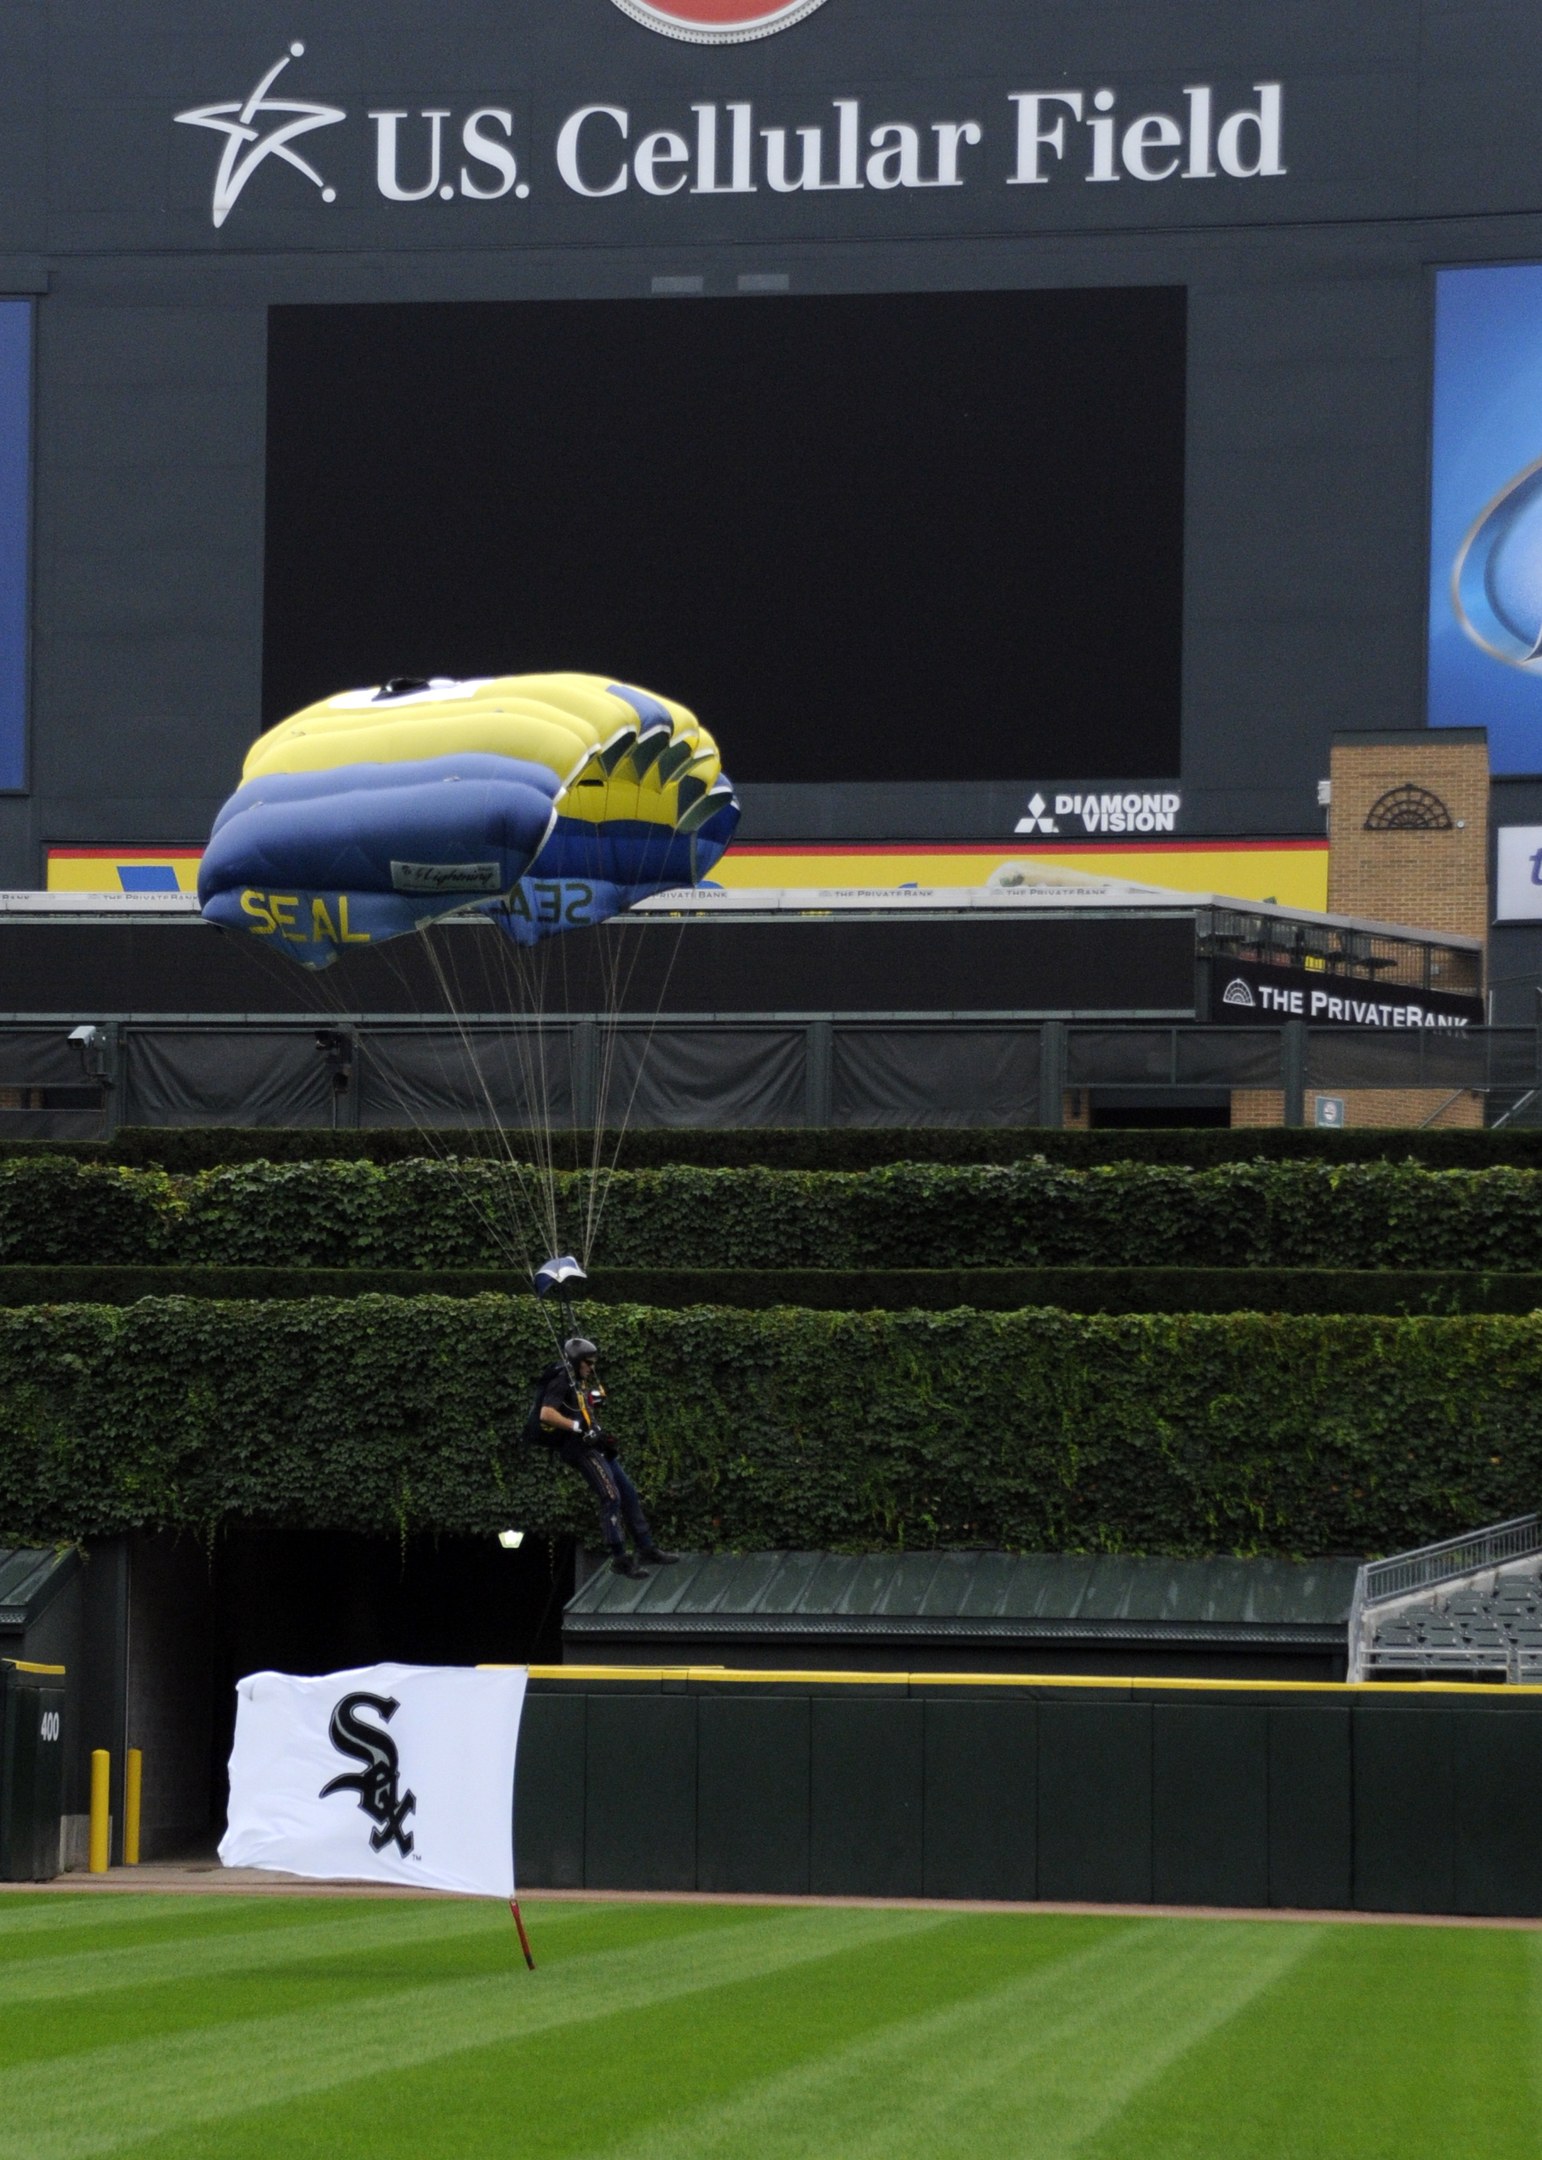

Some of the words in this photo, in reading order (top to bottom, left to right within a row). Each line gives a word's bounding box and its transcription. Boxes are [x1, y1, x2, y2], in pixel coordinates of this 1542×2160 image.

[368, 110, 530, 200] U.S.
[556, 101, 981, 198] Cellular
[1006, 84, 1287, 184] Field
[1055, 794, 1180, 815] DIAMOND
[1082, 812, 1174, 832] VISION
[240, 889, 371, 943] SEAL
[1258, 986, 1304, 1014] THE
[41, 1712, 60, 1741] 400
[319, 1691, 416, 1859] Sox
